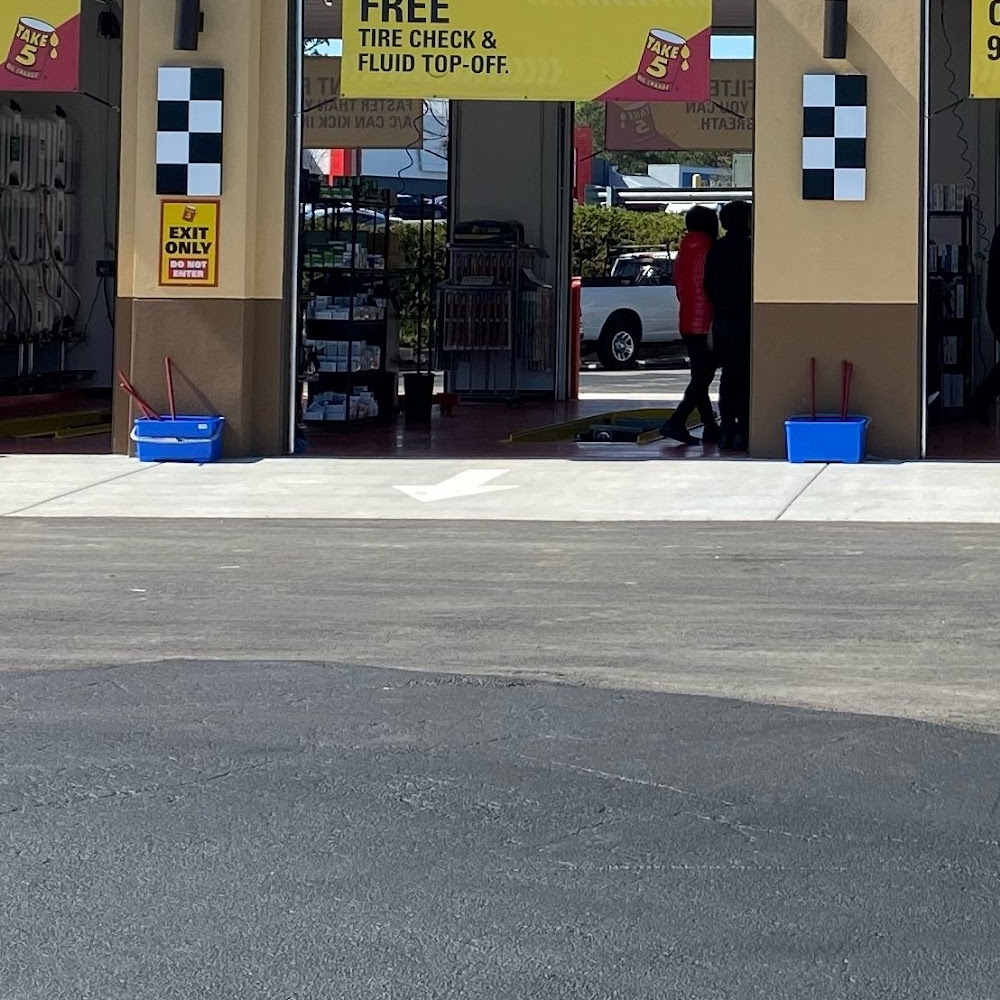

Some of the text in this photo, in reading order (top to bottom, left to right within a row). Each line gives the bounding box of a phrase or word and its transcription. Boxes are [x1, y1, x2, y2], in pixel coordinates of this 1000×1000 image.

[16, 23, 49, 48] TAKE
[358, 29, 498, 49] TIRE CHECK &
[14, 42, 39, 67] 5
[646, 35, 680, 60] TAKE
[358, 53, 510, 74] FLUID TOP-OFF.
[645, 55, 669, 78] 5
[169, 226, 209, 240] EXIT
[165, 241, 213, 255] ONLY
[169, 260, 208, 269] DO NOT
[172, 269, 205, 278] ENTER
